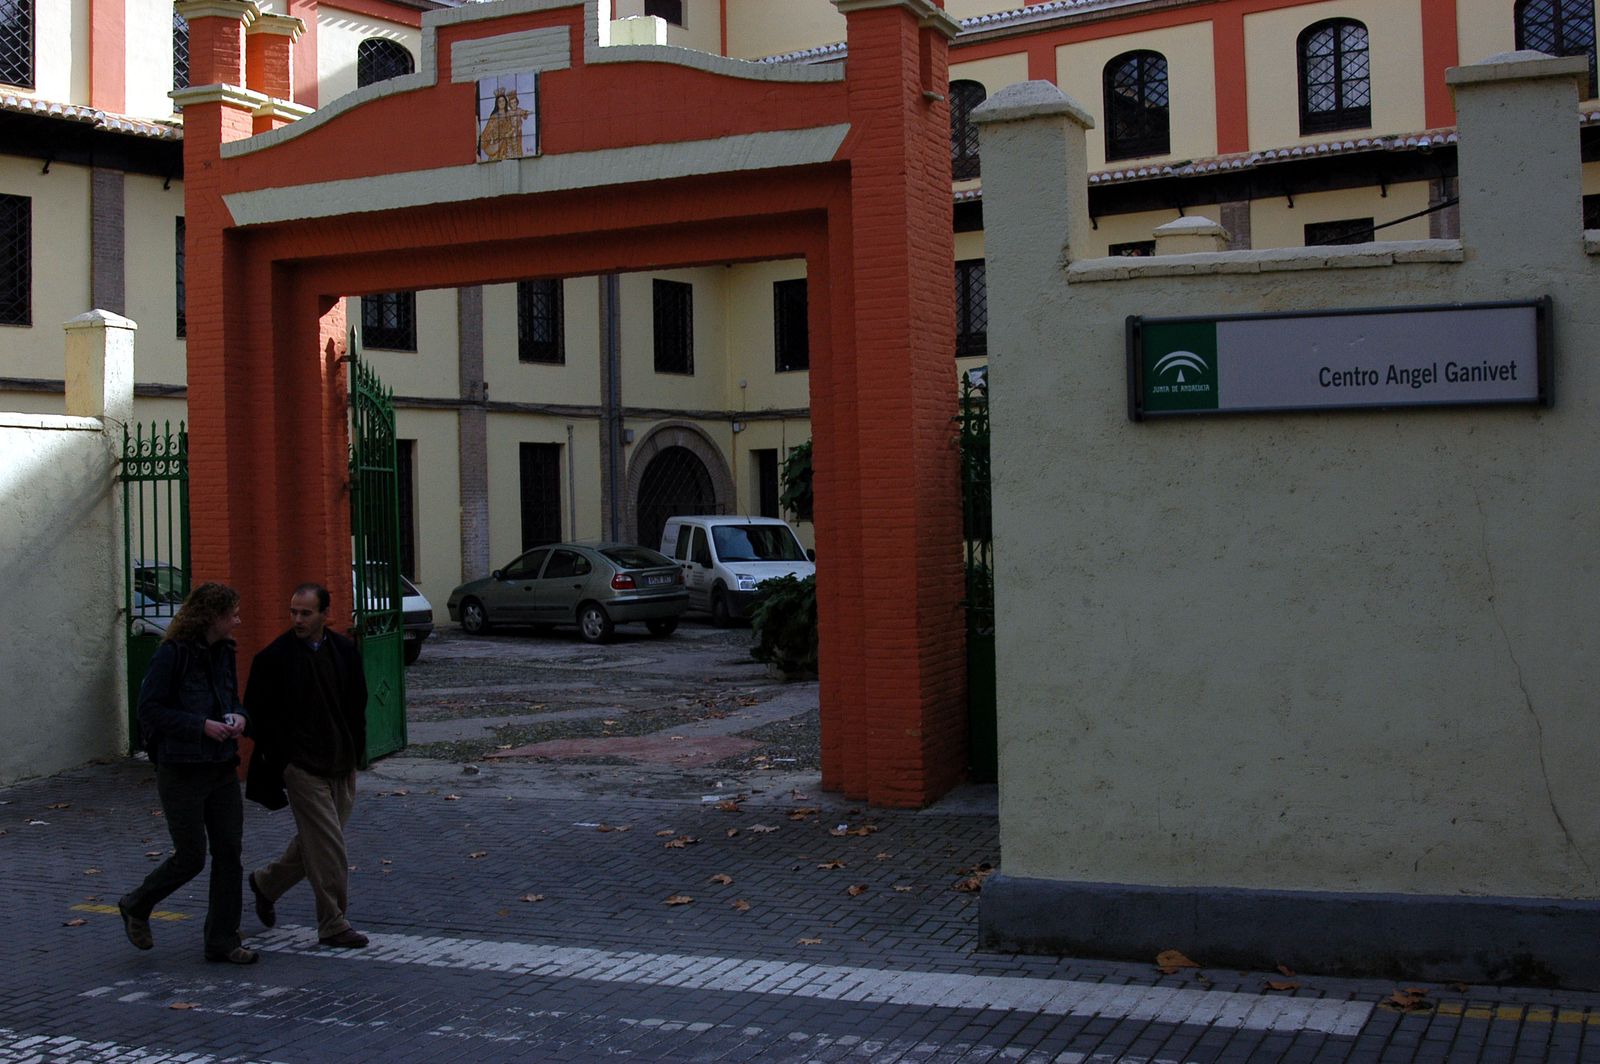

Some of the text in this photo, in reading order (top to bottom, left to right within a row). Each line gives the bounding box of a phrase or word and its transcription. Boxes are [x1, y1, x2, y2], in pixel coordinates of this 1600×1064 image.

[1319, 360, 1518, 388] Centro Angel Ganivet
[1152, 385, 1170, 394] JUNTA
[1171, 385, 1179, 393] DE
